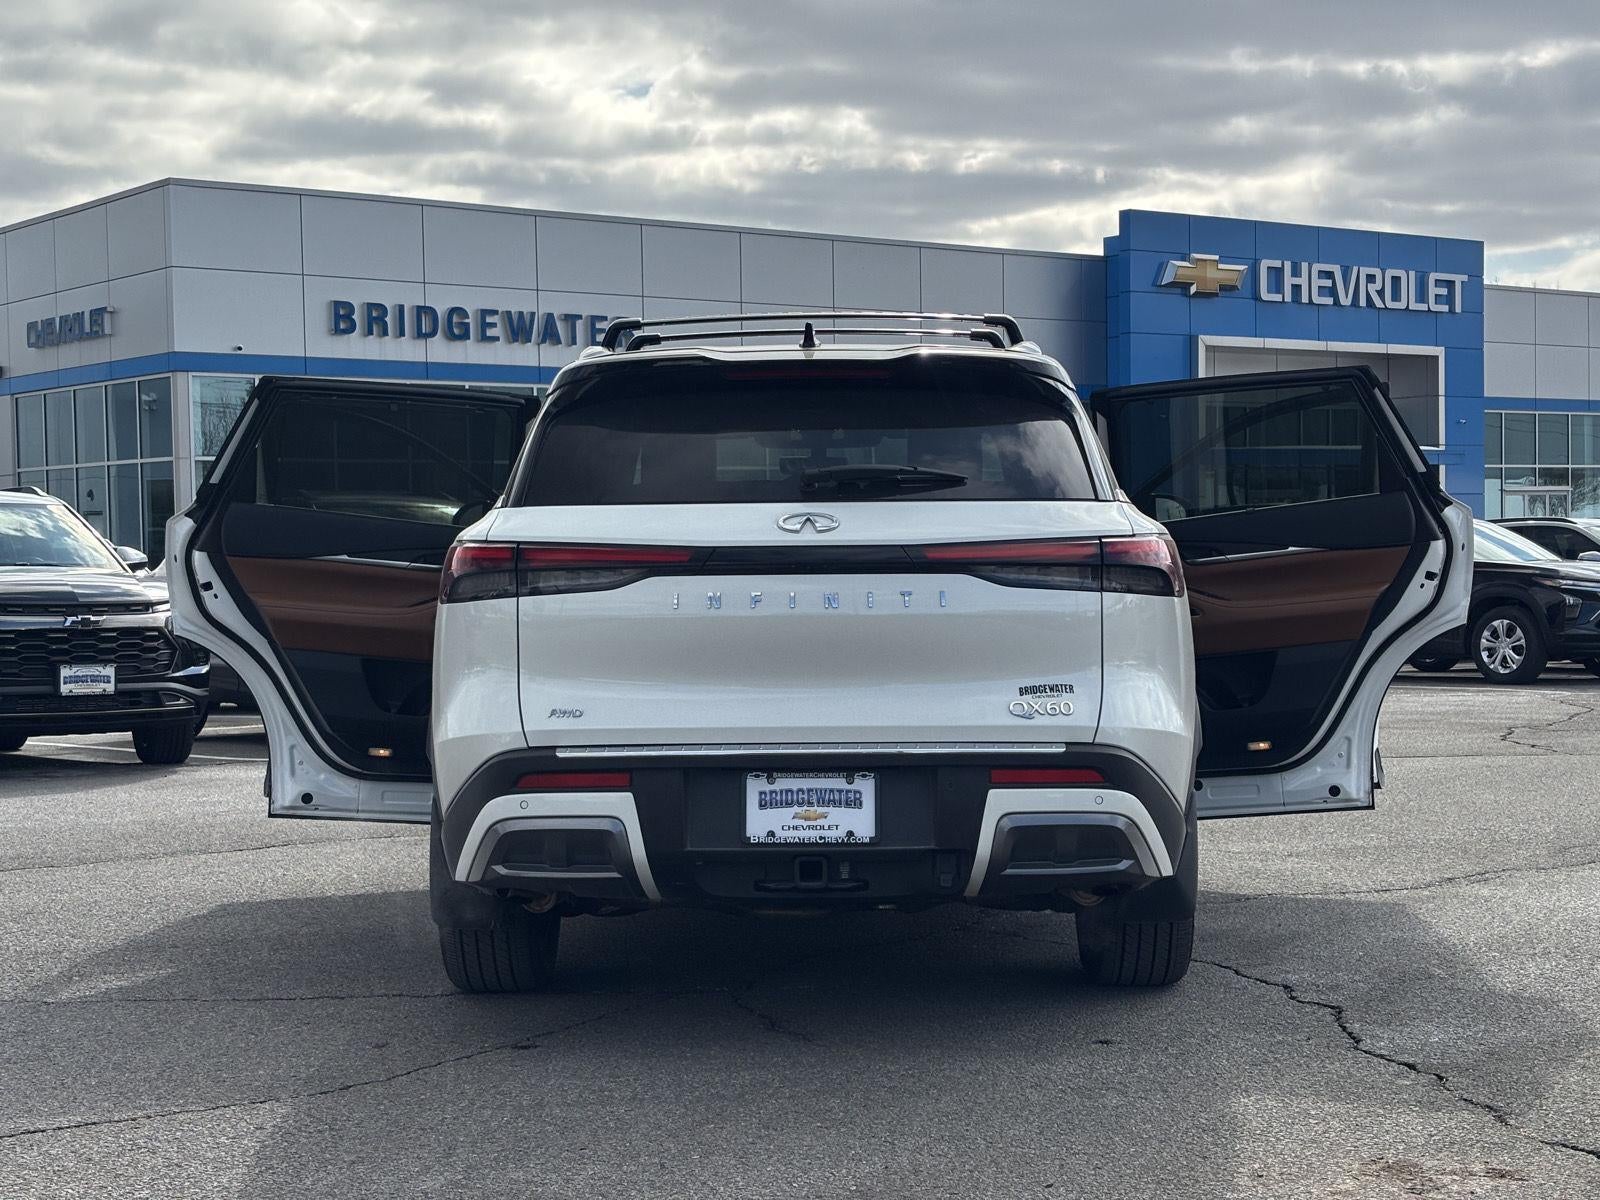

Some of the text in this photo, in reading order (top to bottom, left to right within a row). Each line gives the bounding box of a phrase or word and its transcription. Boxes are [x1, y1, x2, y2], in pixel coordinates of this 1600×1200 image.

[1259, 259, 1469, 313] CHEVROLET
[672, 591, 948, 609] INFINITI
[1018, 684, 1075, 697] BRIDGEWATER
[547, 708, 584, 719] AWD
[1009, 700, 1074, 720] QX60
[758, 787, 864, 811] BRIDGEWATER
[781, 824, 841, 832] CHEVROLET
